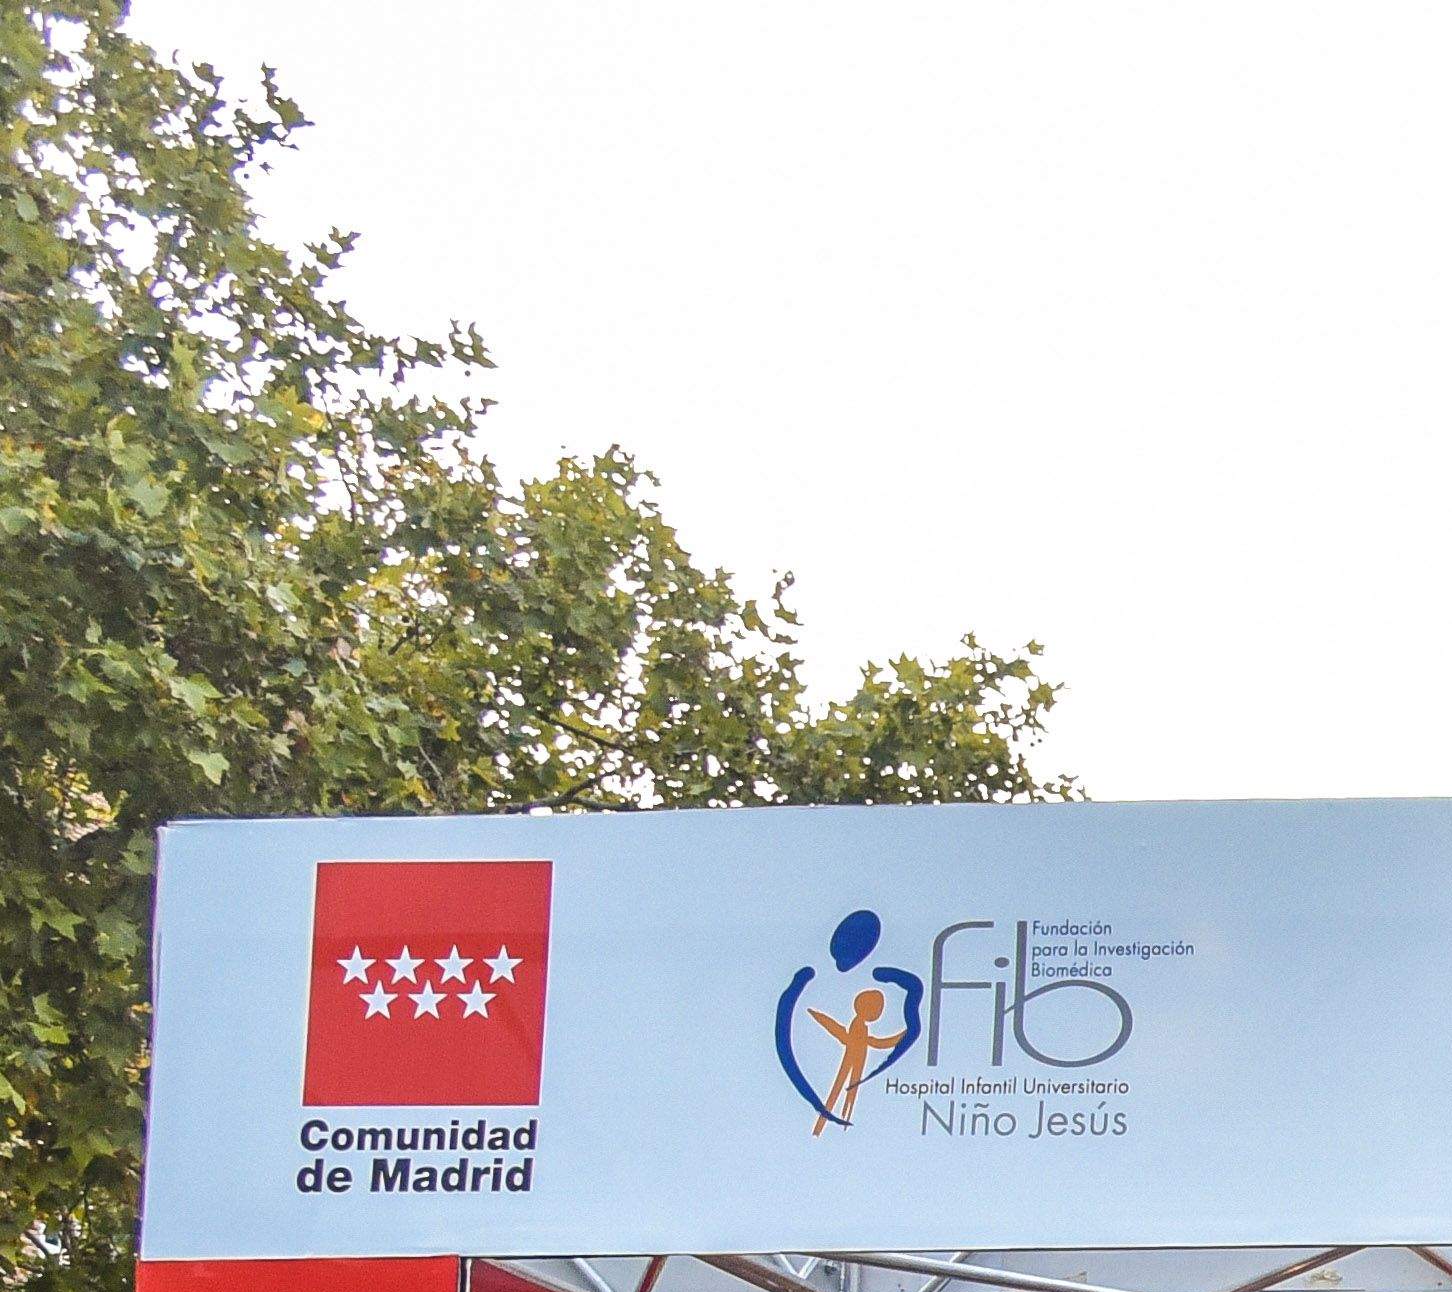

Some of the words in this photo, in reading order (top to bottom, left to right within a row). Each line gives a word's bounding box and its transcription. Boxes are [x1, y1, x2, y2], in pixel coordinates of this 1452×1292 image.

[1031, 920, 1113, 937] Fundación
[1032, 943, 1068, 959] para
[1073, 940, 1088, 957] la
[1094, 939, 1195, 961] Investigación
[1031, 962, 1113, 978] Biomédica
[926, 920, 1134, 1069] fib
[884, 1077, 954, 1099] Hospital
[961, 1077, 1017, 1096] Infantil
[1023, 1077, 1130, 1096] Universitario
[920, 1100, 1017, 1138] Niño
[1028, 1100, 1128, 1139] Jesús
[298, 1117, 539, 1154] Comunidad
[296, 1156, 352, 1193] de
[369, 1156, 534, 1194] Madrid
